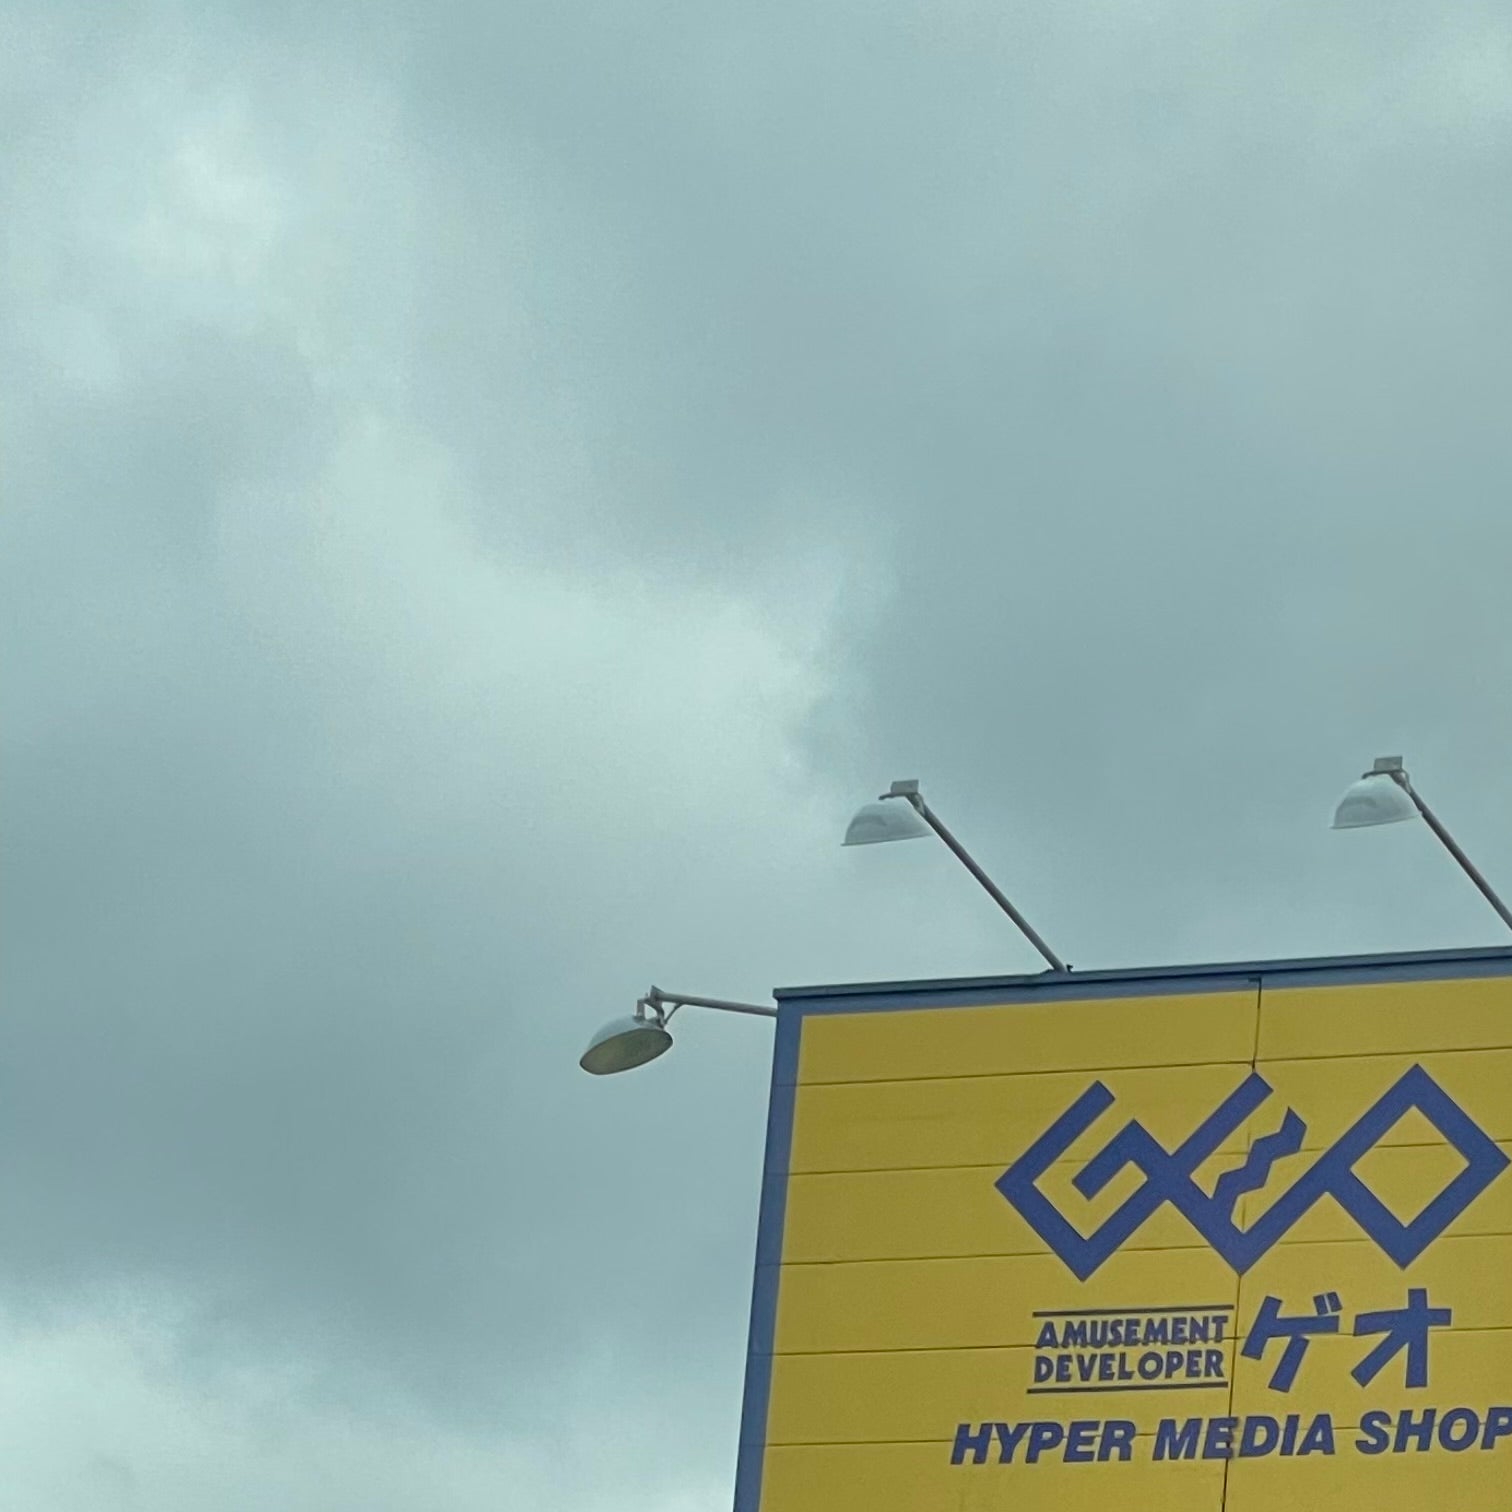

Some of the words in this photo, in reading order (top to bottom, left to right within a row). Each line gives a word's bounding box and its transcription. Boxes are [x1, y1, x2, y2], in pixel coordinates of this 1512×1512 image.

[1034, 1315, 1229, 1350] AMUSEMENT
[1241, 1288, 1452, 1393] ゲオ
[1033, 1348, 1226, 1384] DEVELOPER
[951, 1419, 1134, 1465] HYPER
[1152, 1413, 1336, 1461] MEDIA
